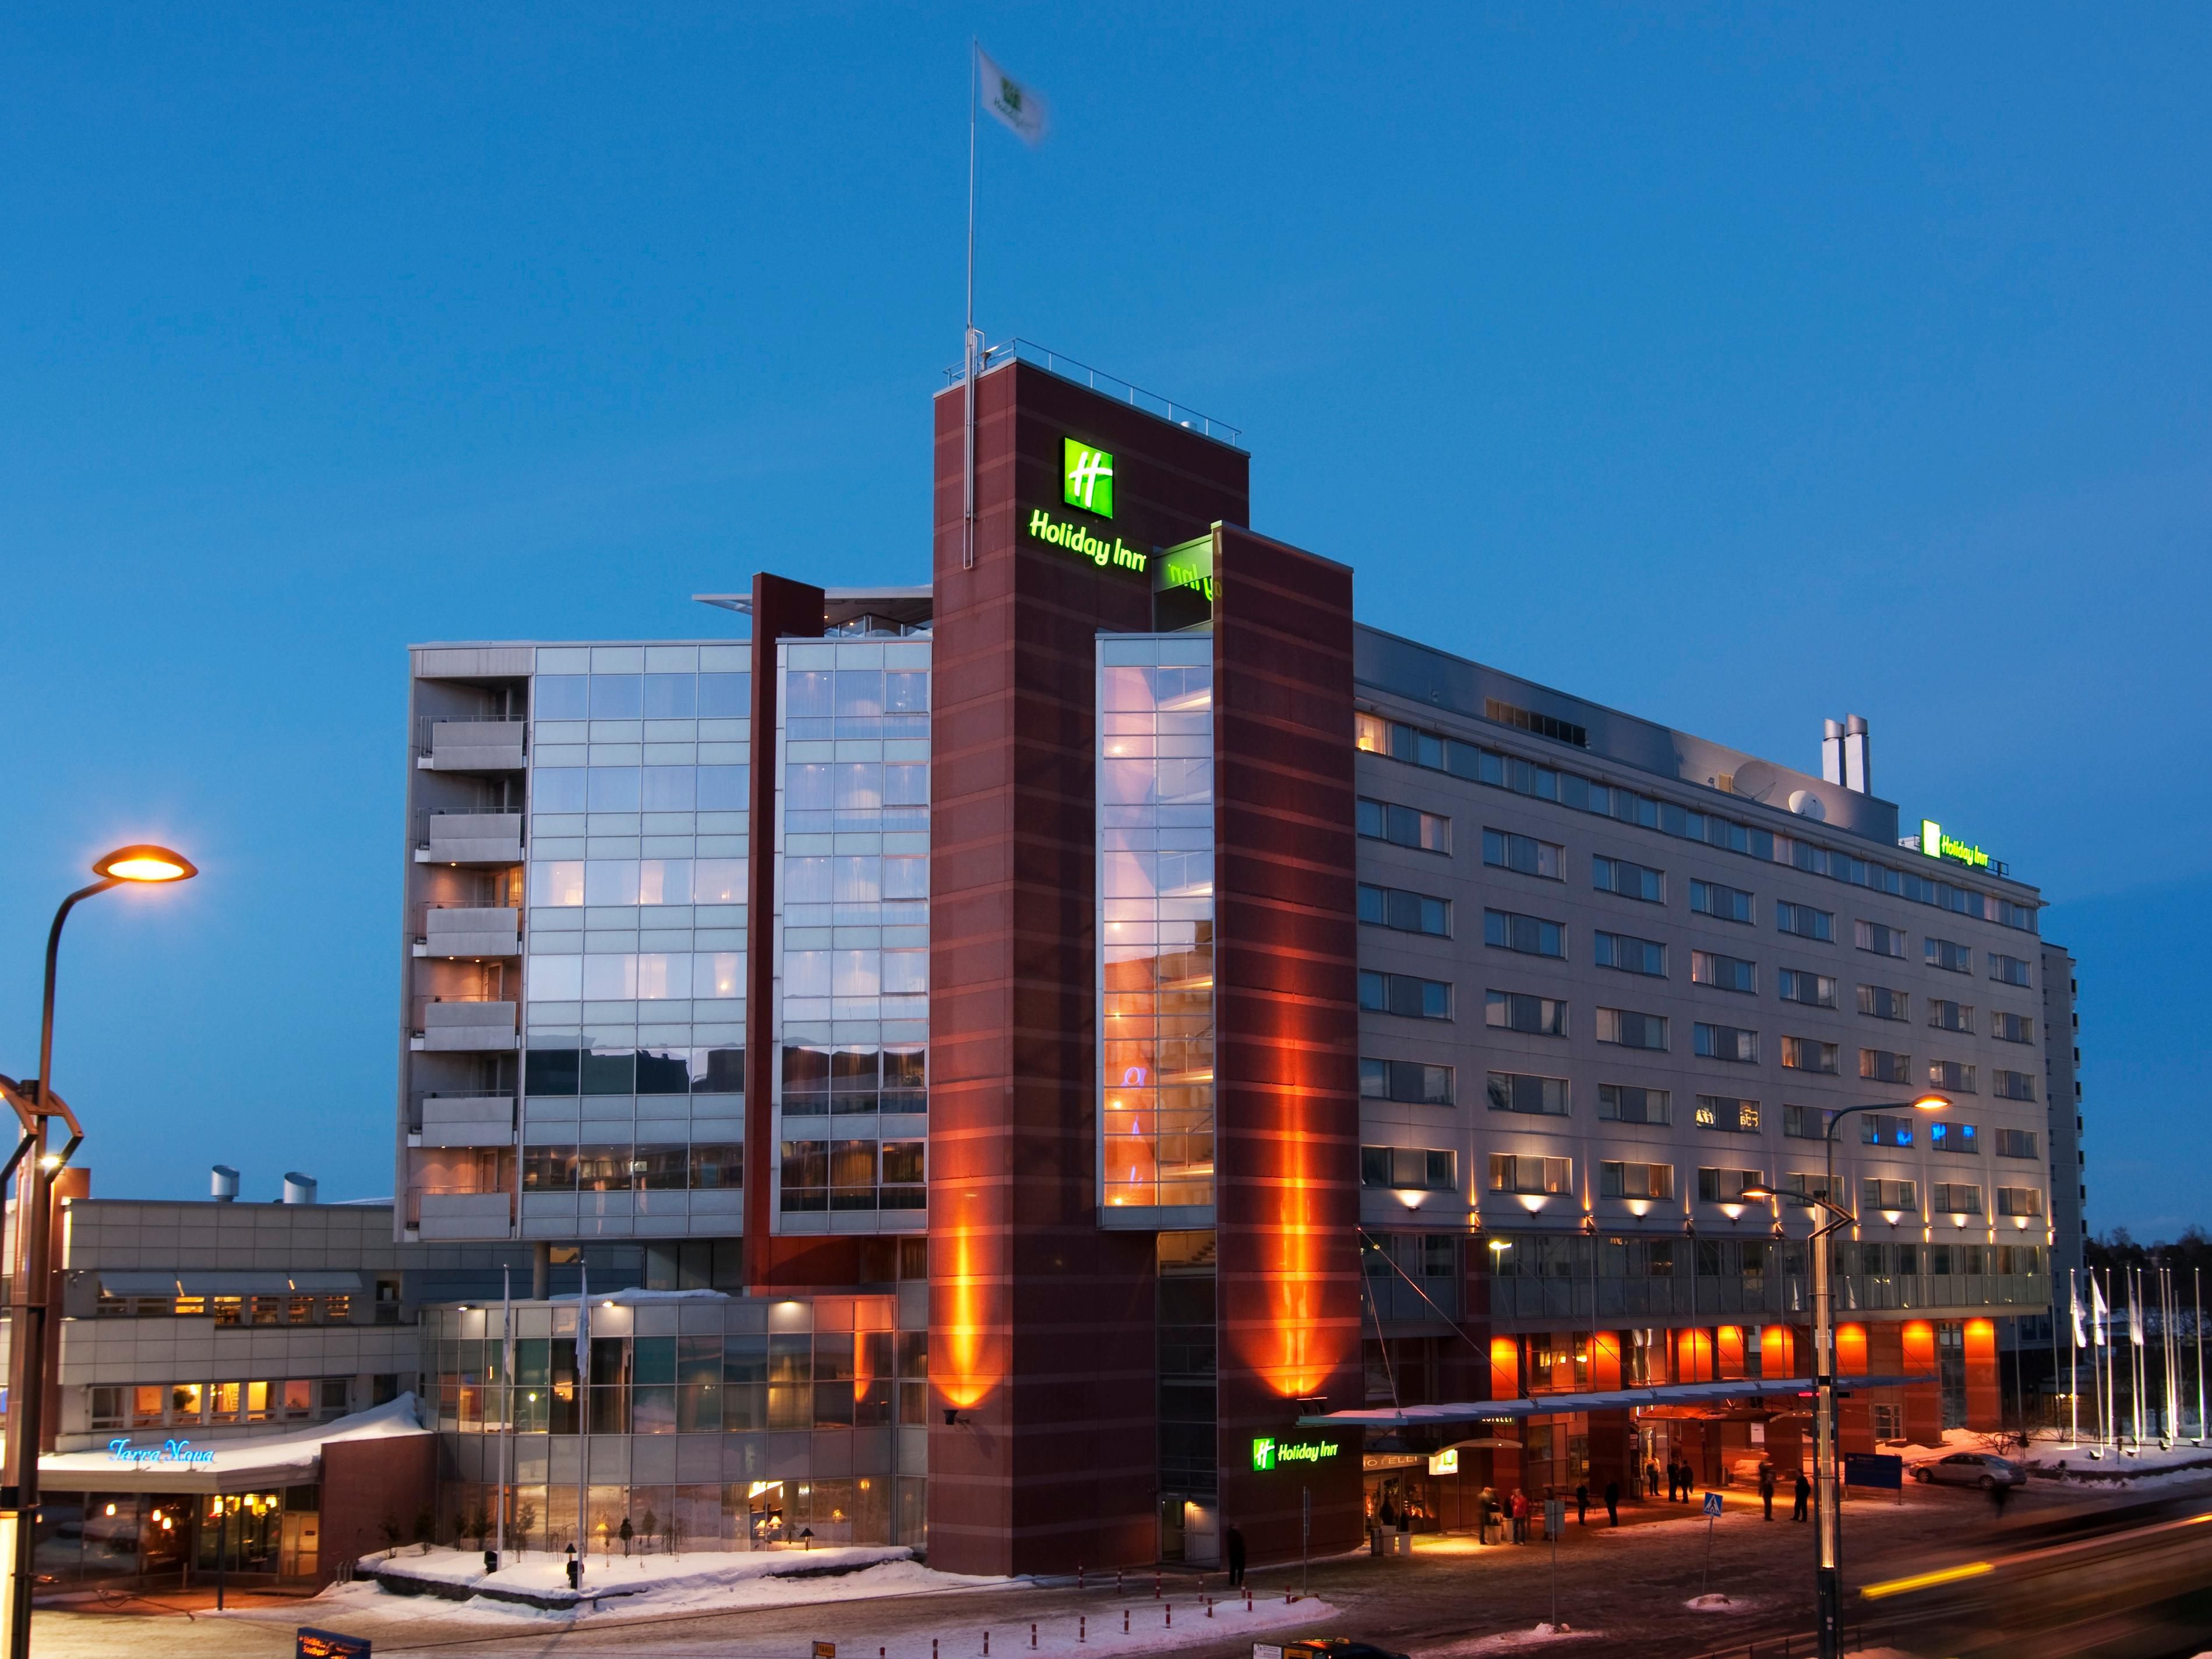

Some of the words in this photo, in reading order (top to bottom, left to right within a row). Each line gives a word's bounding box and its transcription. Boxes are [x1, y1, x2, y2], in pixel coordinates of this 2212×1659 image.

[1029, 509, 1110, 566] Holiday
[1113, 538, 1145, 572] Inn
[1942, 834, 1974, 866] Holiday
[1974, 845, 1989, 867] Inn
[108, 1438, 161, 1462] Terra
[1278, 1442, 1319, 1462] Holiday
[1320, 1440, 1338, 1457] Inn
